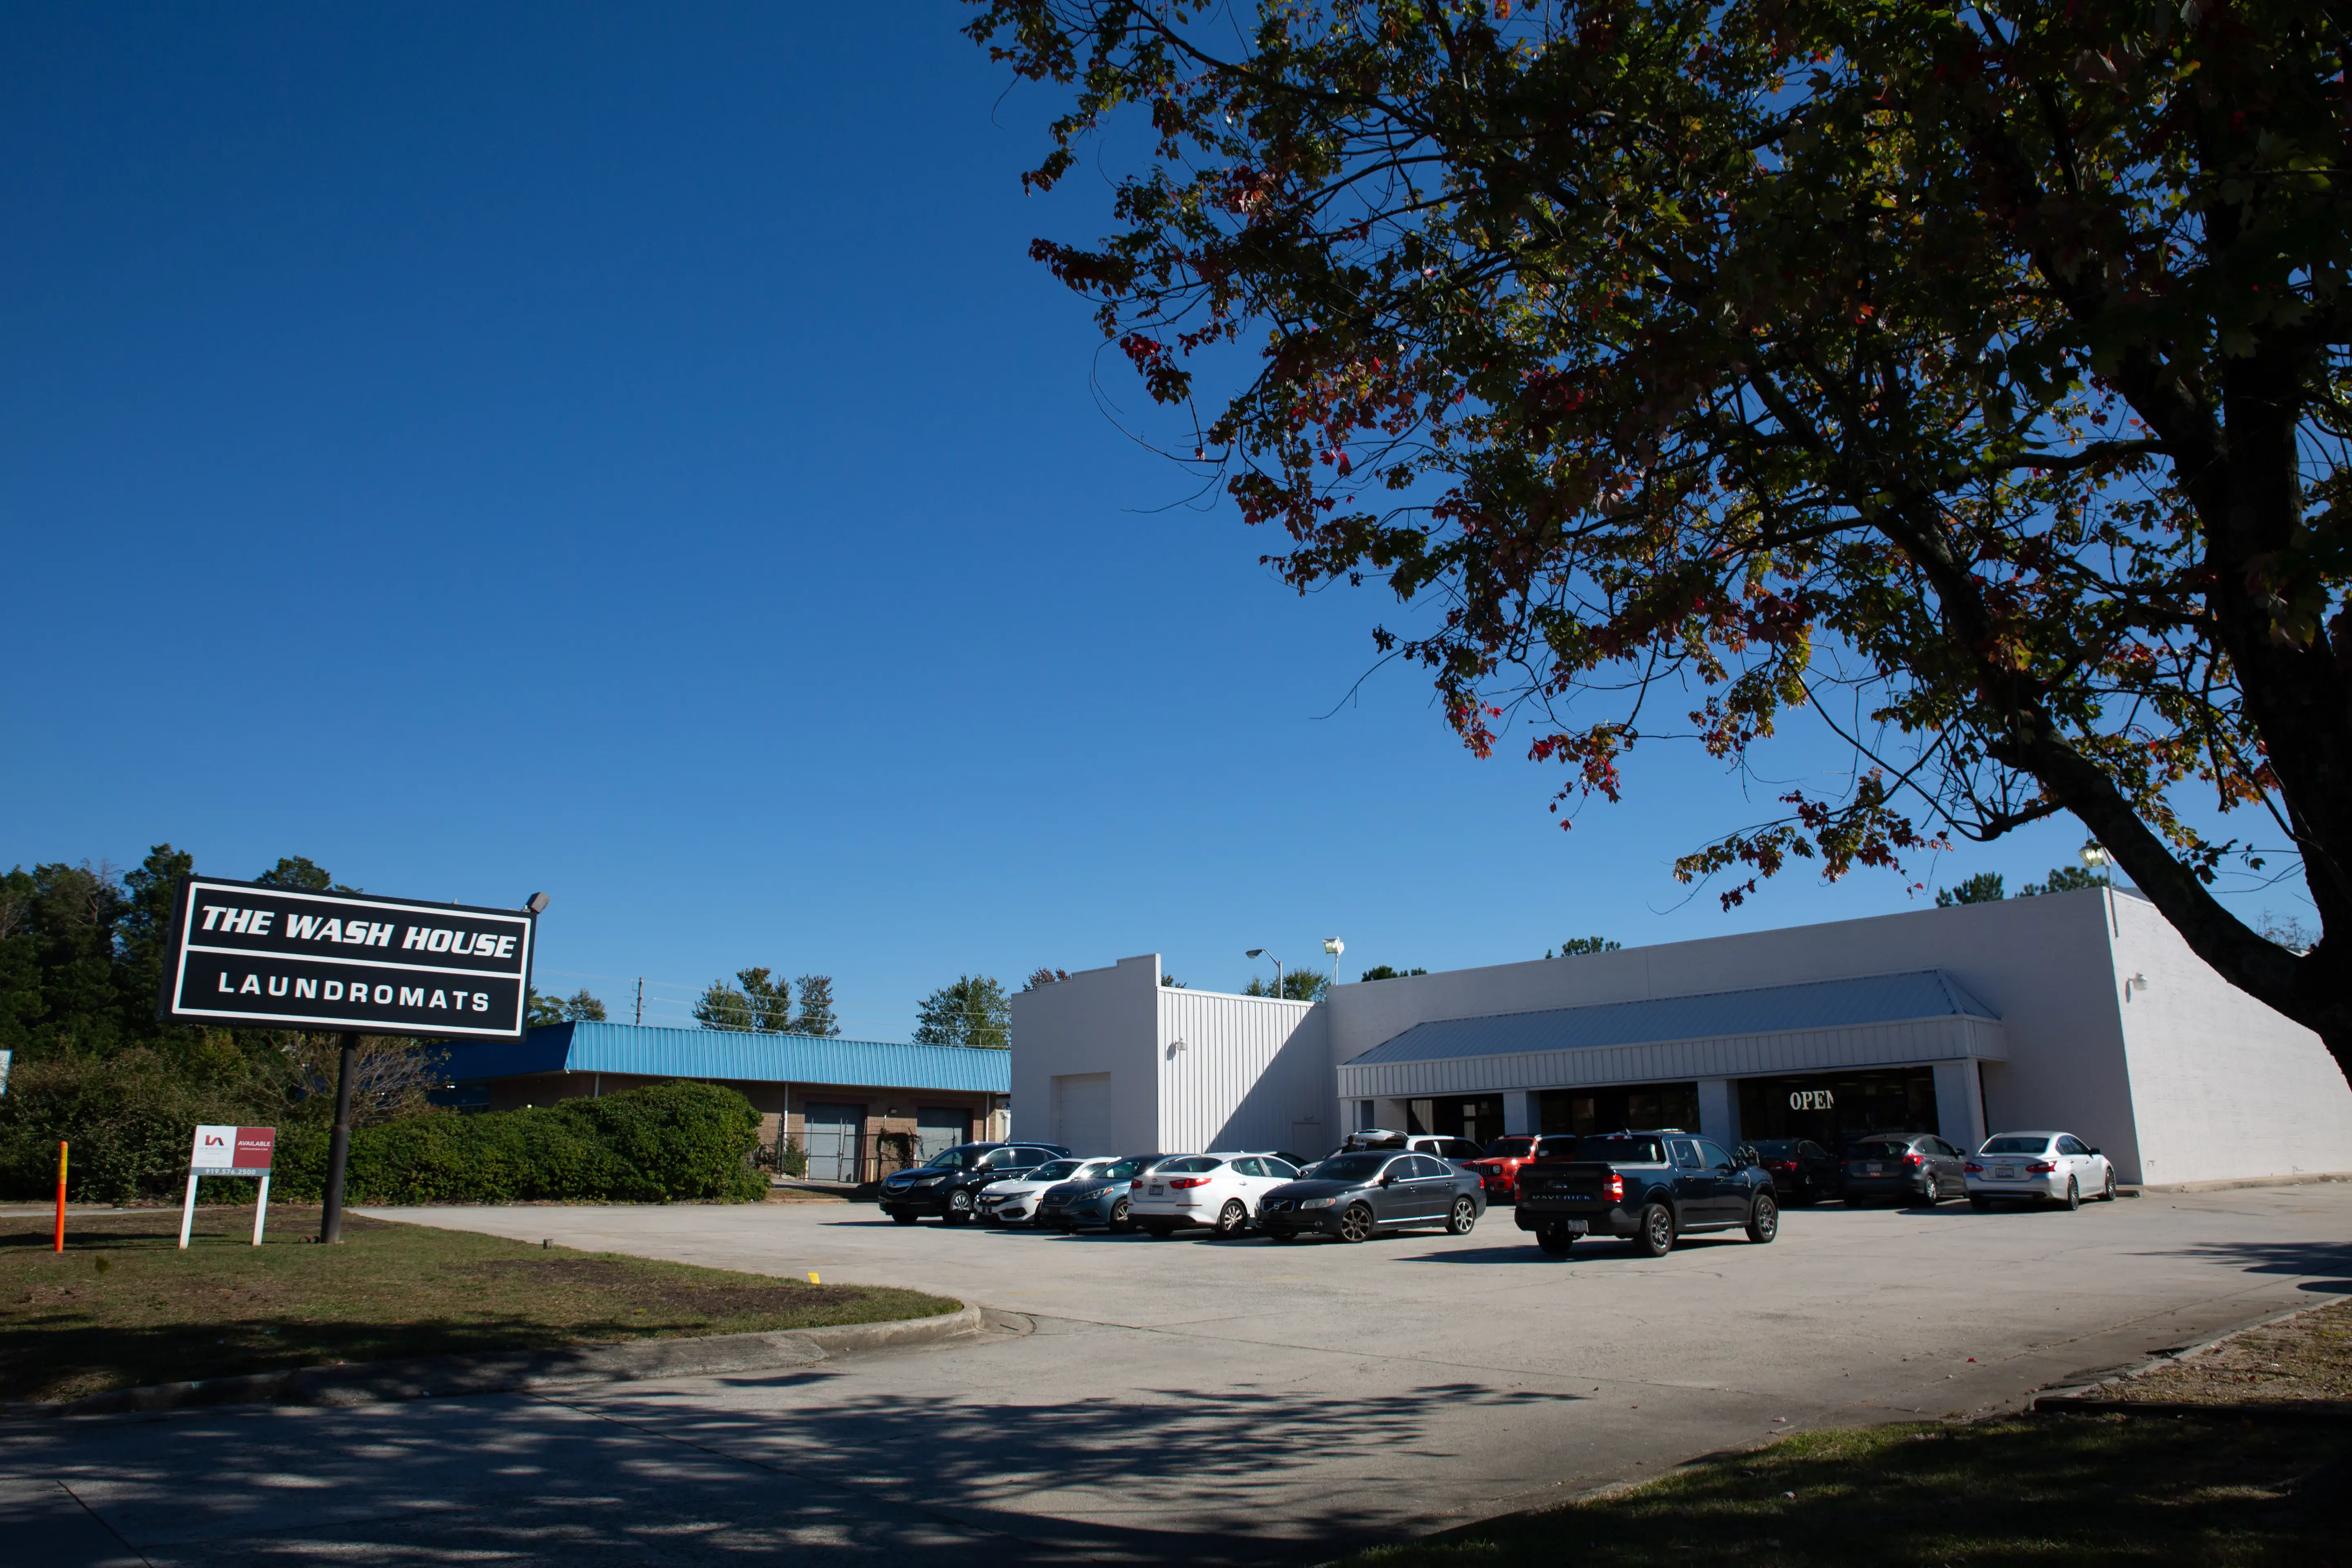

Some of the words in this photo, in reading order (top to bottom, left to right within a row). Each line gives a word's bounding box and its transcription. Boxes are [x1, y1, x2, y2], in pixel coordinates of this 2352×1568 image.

[202, 905, 274, 935] THE
[286, 914, 394, 947] WASH
[401, 926, 517, 958] HOUSE
[218, 972, 488, 1011] LAUNDROMATS
